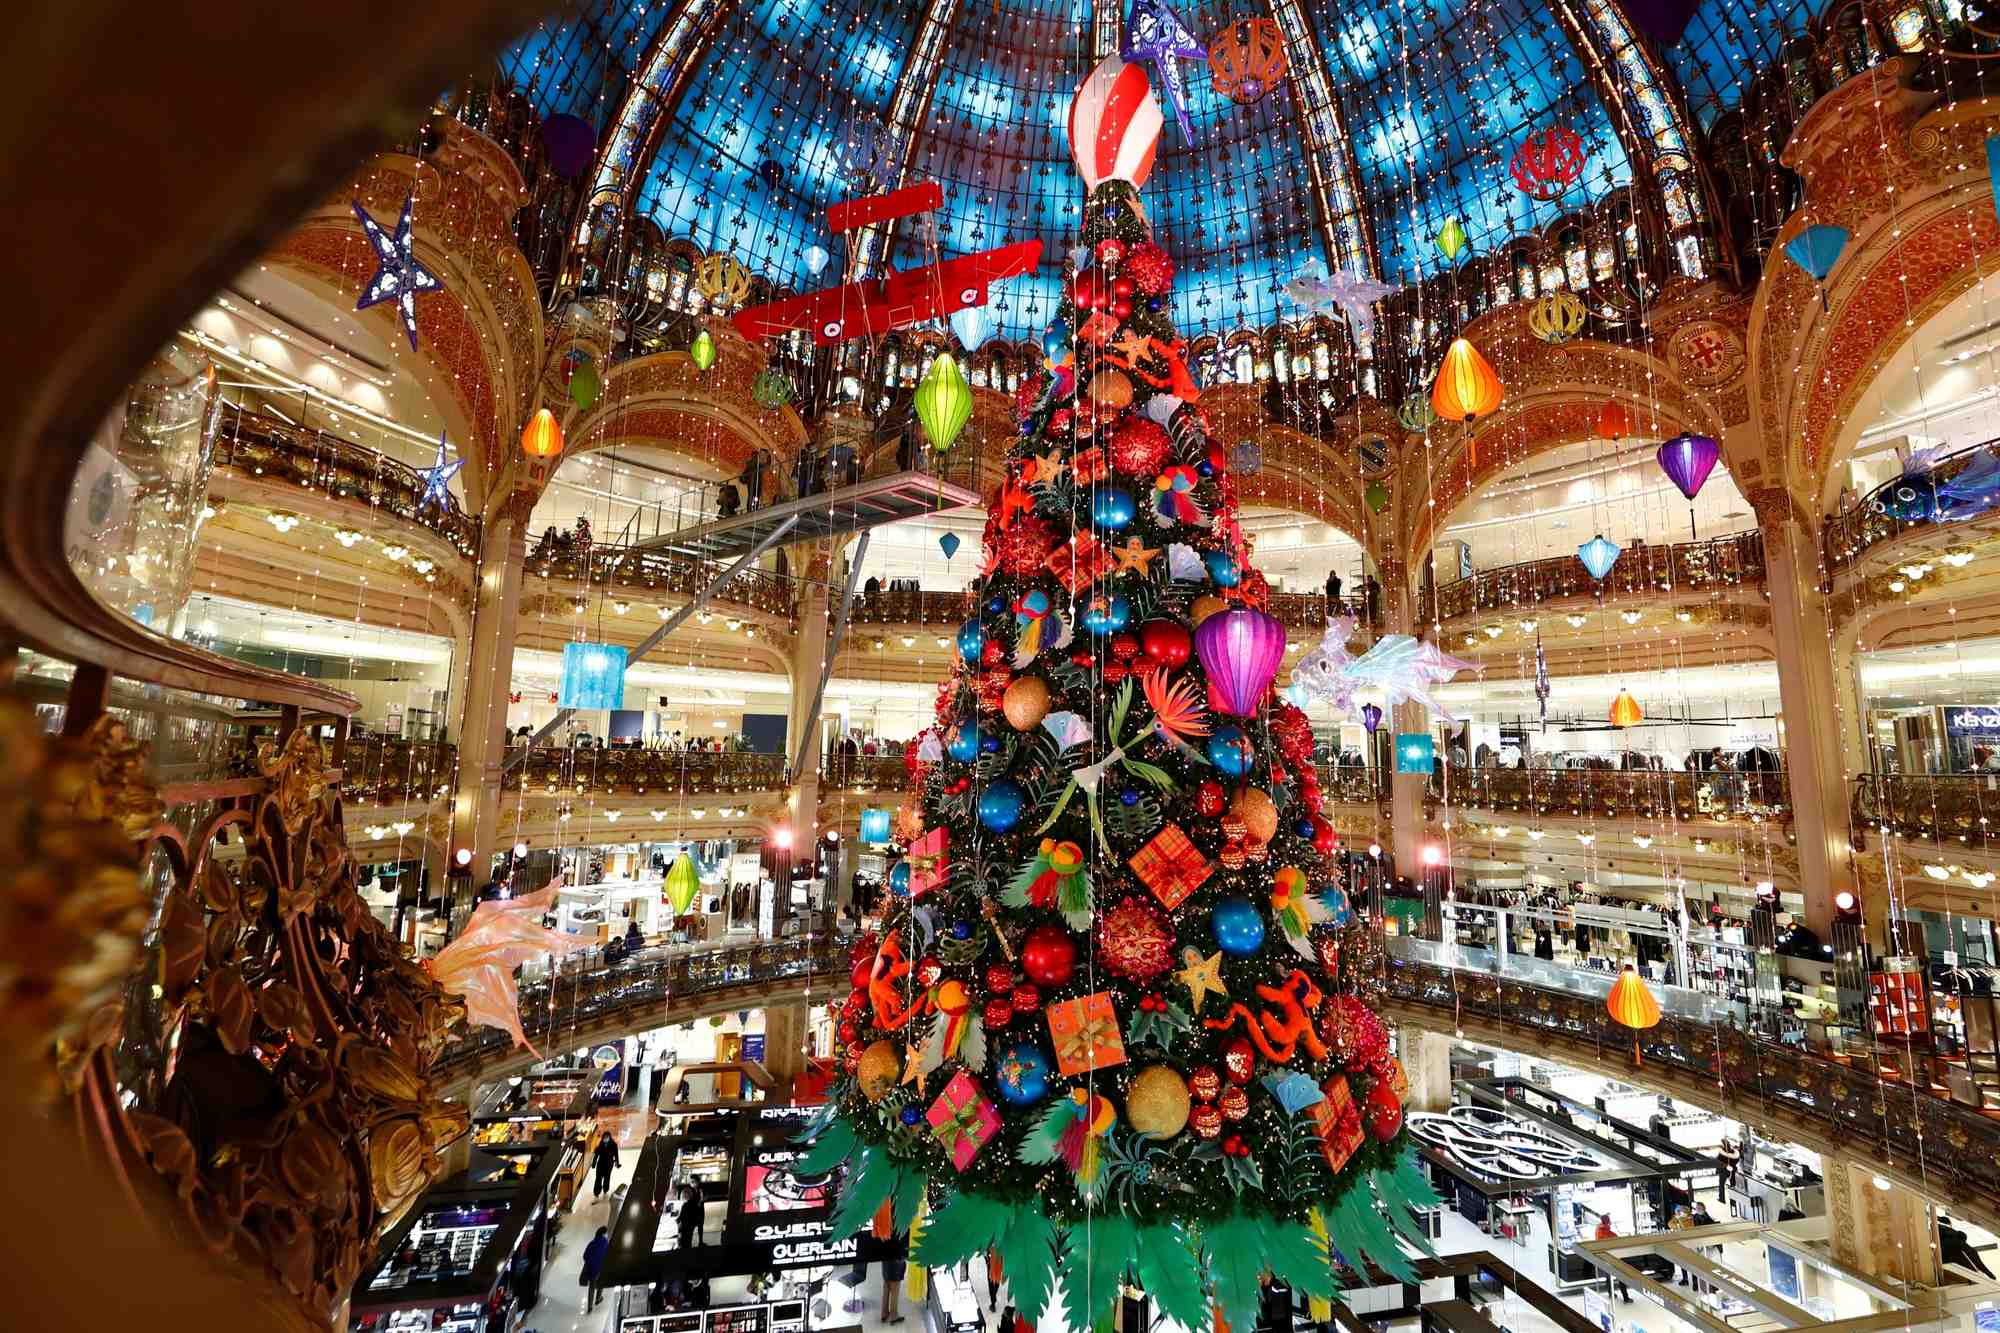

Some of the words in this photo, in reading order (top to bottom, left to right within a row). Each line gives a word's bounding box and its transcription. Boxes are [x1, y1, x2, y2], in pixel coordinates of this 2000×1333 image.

[1953, 710, 2000, 728] KENZ
[1680, 1168, 1717, 1178] GIVENCHY
[773, 1238, 857, 1259] GUERLAIN
